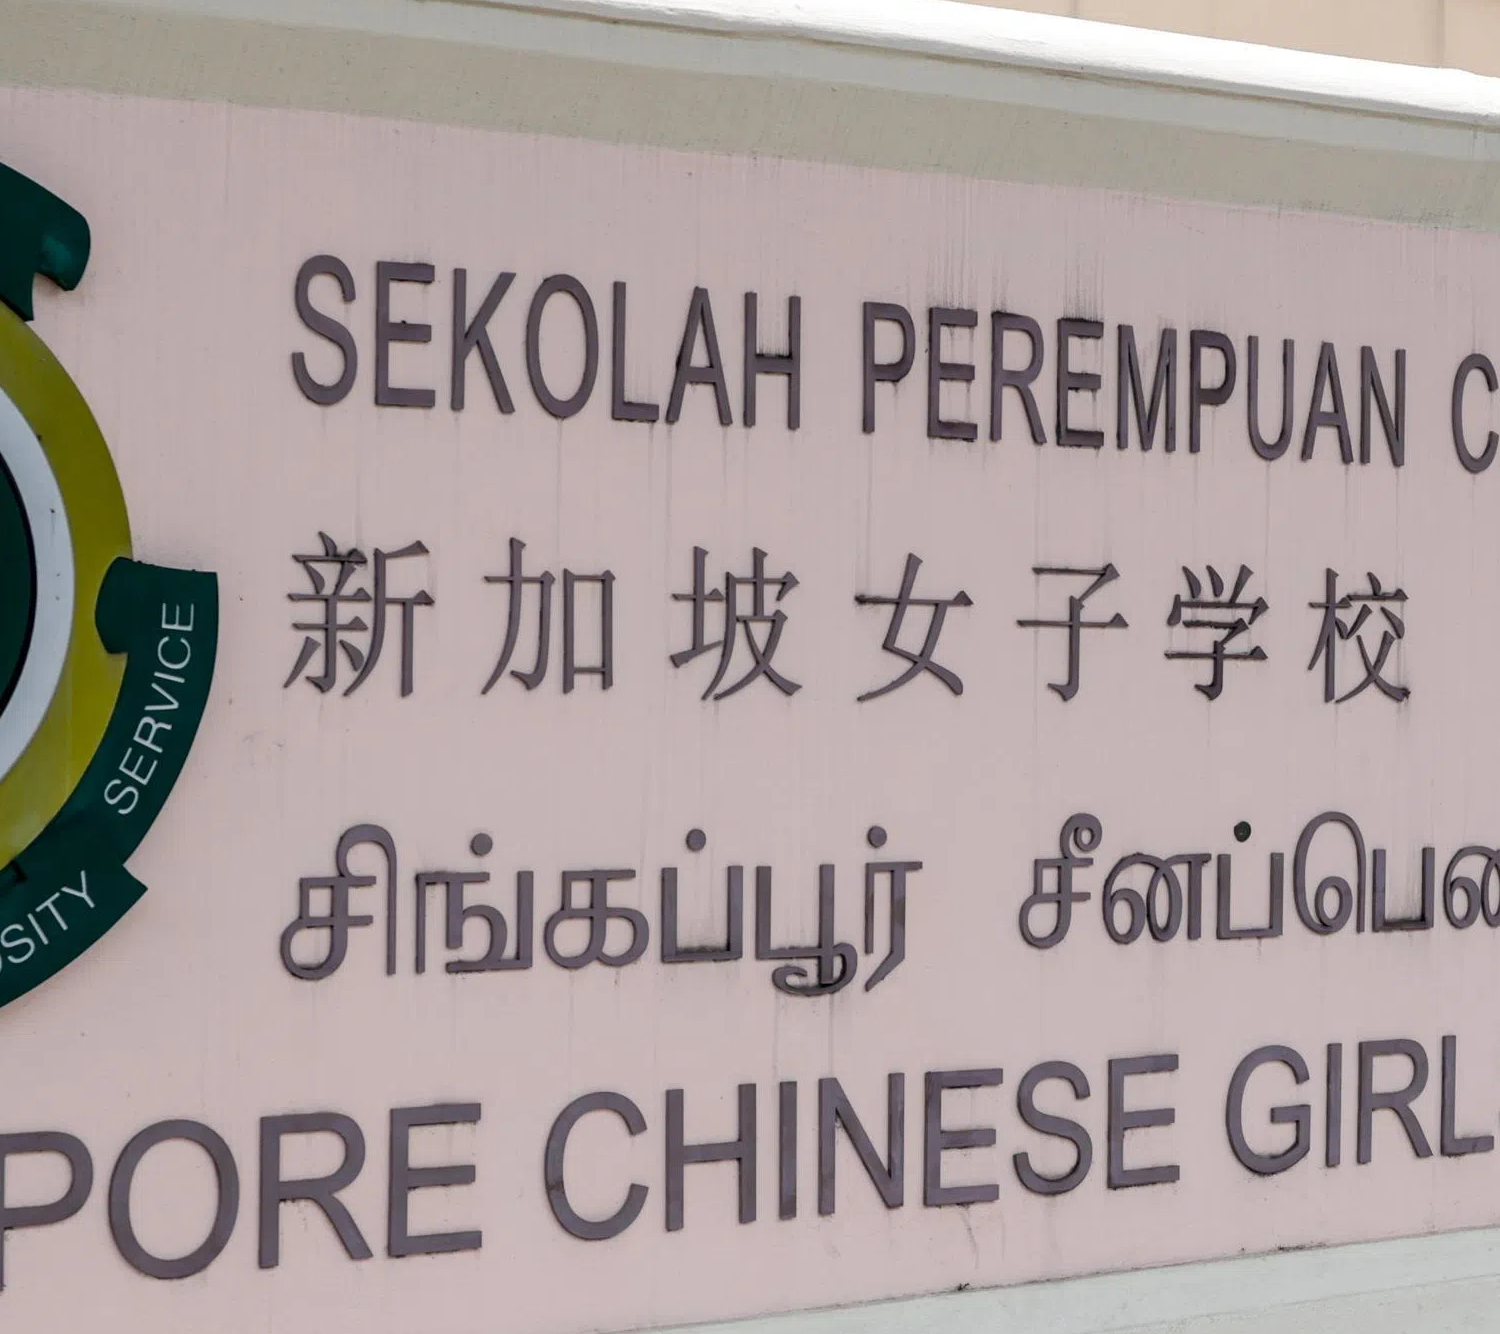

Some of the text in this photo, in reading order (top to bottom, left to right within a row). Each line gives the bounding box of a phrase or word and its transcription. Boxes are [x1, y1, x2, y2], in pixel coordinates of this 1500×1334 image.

[290, 254, 803, 432] SEKOLAH
[861, 301, 1408, 469] PEREMPUAN
[103, 601, 196, 816] SERVICE
[282, 530, 1412, 705] 新加坡女子学校
[278, 822, 925, 999] சிங்கப்பூர்
[542, 1053, 1182, 1243] CHINESE
